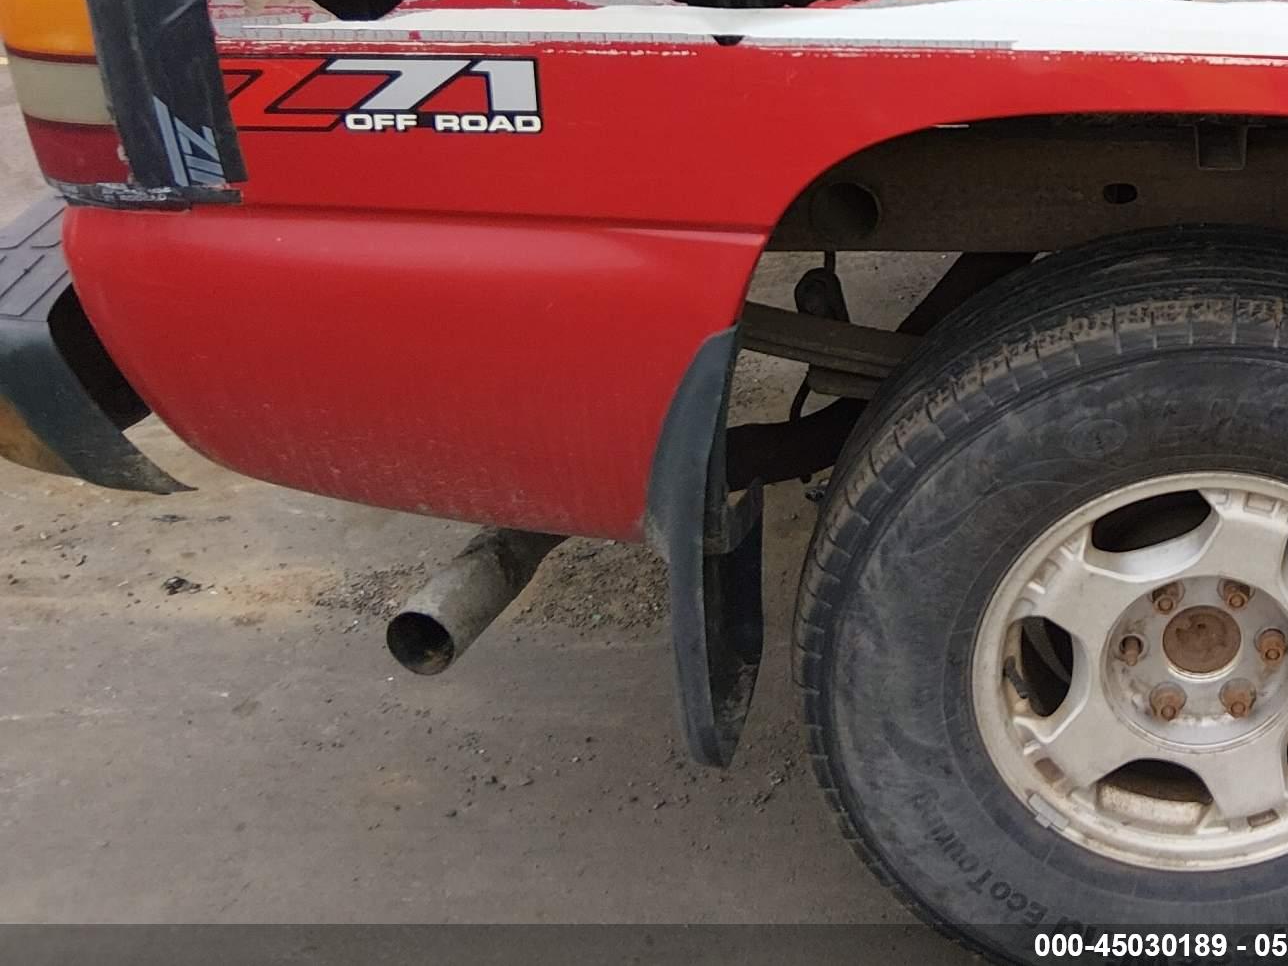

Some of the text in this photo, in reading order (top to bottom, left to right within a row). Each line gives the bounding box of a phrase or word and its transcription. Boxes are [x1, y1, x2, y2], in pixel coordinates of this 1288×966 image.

[219, 57, 538, 128] Z71
[345, 113, 543, 133] OFF ROAD
